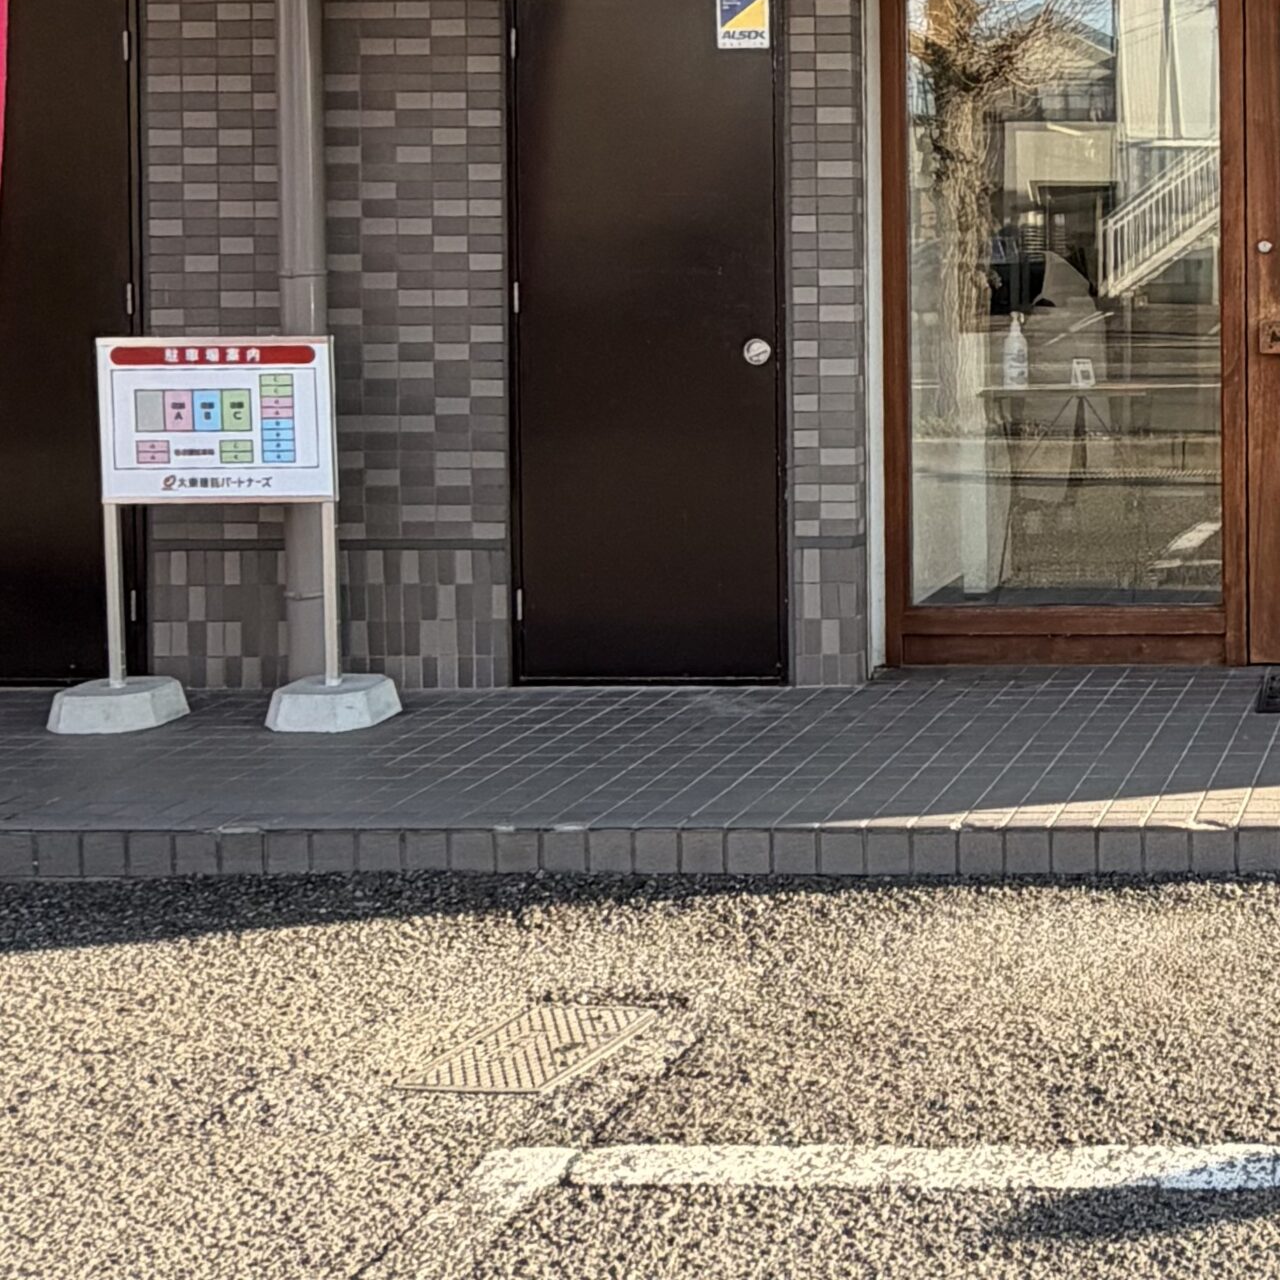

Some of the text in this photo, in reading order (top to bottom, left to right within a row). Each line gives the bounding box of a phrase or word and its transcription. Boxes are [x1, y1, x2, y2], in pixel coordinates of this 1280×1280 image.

[721, 30, 766, 40] ALSOK
[164, 347, 261, 362] 駐車場案内
